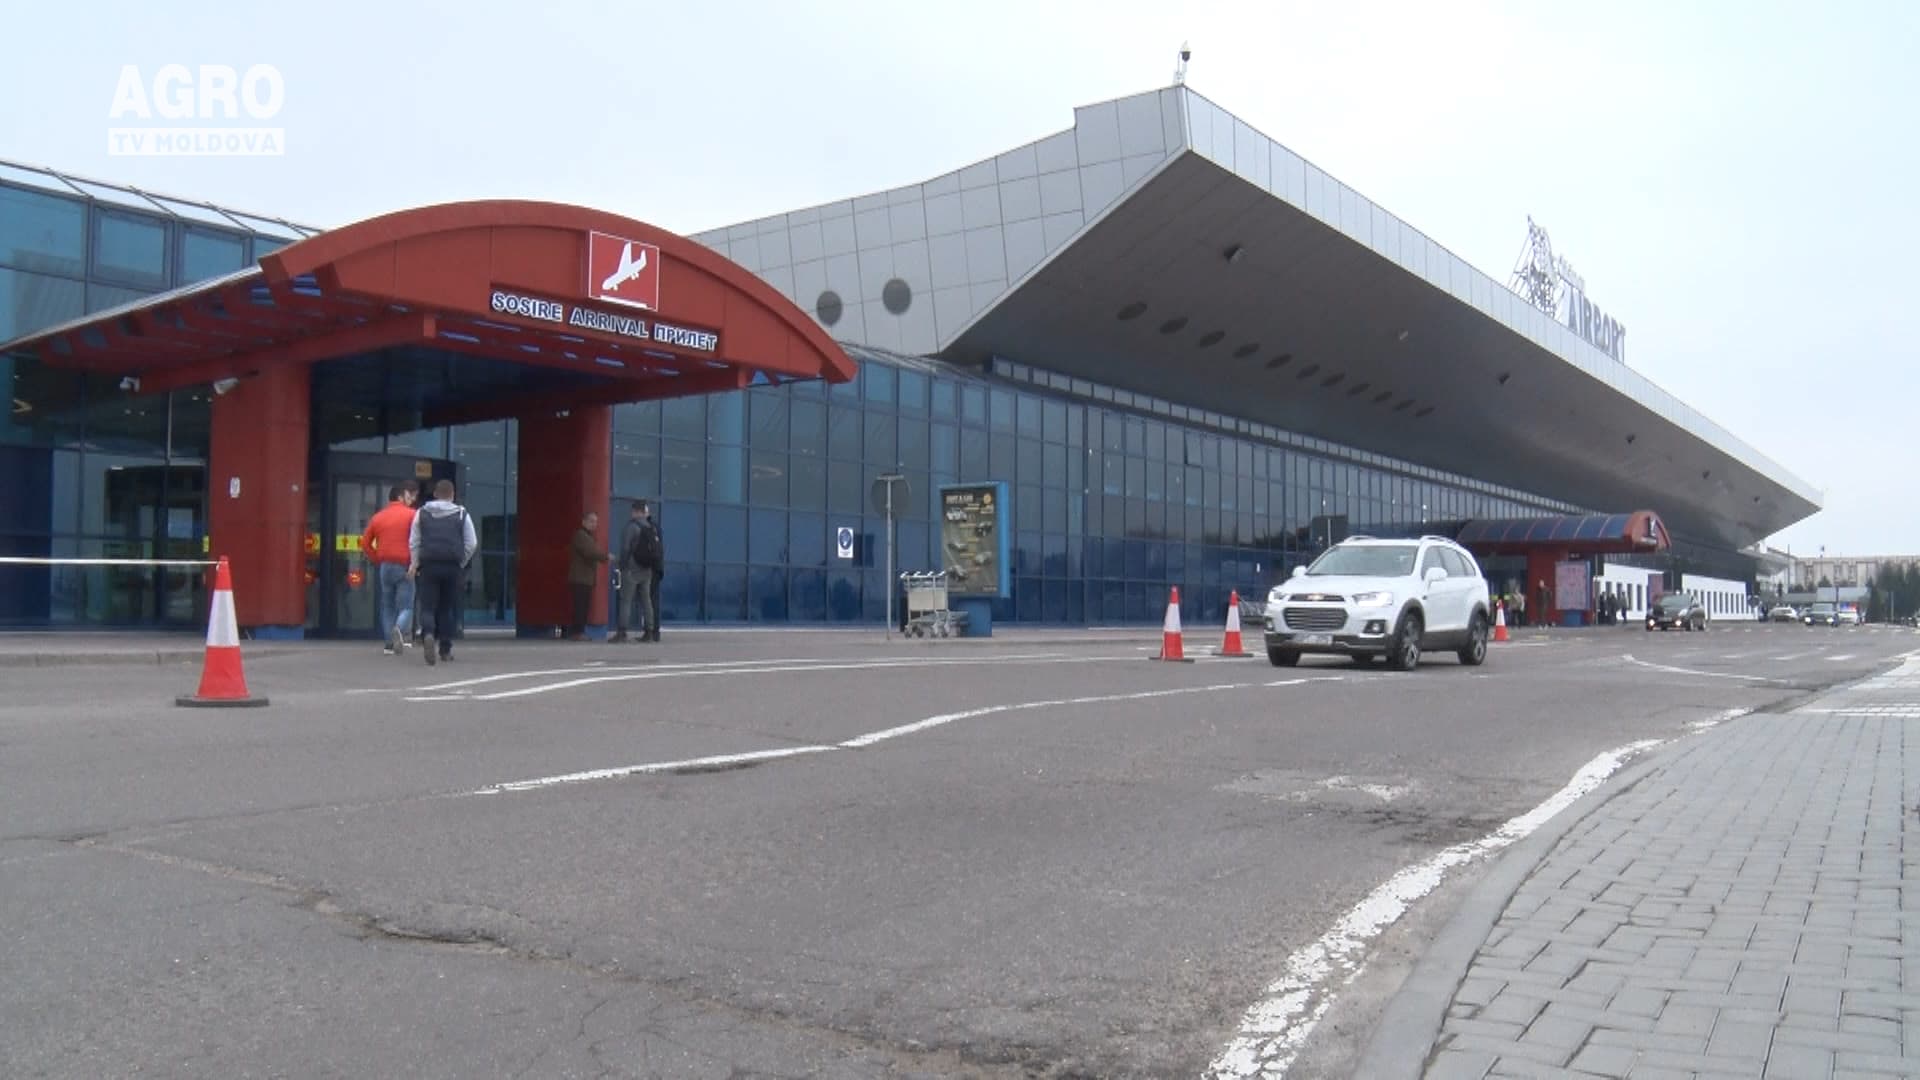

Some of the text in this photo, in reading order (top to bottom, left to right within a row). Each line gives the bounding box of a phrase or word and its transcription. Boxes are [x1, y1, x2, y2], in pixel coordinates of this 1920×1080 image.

[491, 291, 718, 352] SOSIRE ARRIVAL ПРИЛЕТ
[1567, 286, 1626, 365] AIRPORT
